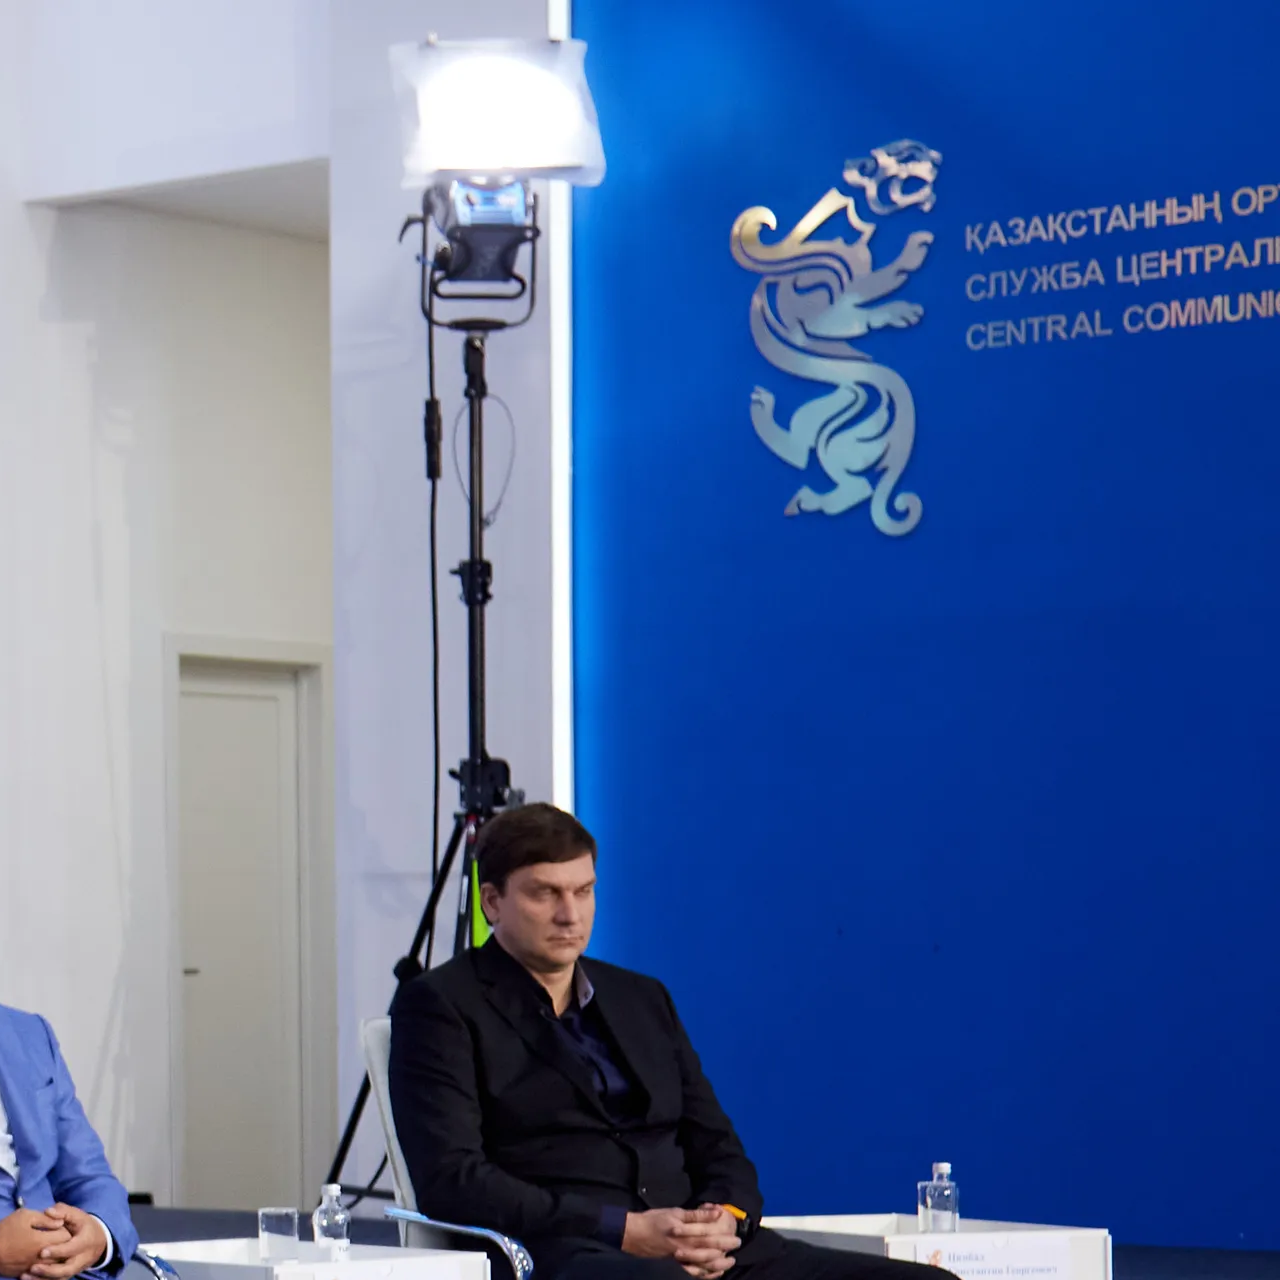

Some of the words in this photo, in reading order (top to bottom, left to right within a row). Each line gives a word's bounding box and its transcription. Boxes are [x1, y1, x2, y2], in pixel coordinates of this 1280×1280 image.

[965, 190, 1223, 255] ҚАЗАҚСТАННЫҢ
[1231, 183, 1280, 217] ОР
[966, 259, 1105, 303] СЛУЖБА
[966, 309, 1112, 351] CENTRAL
